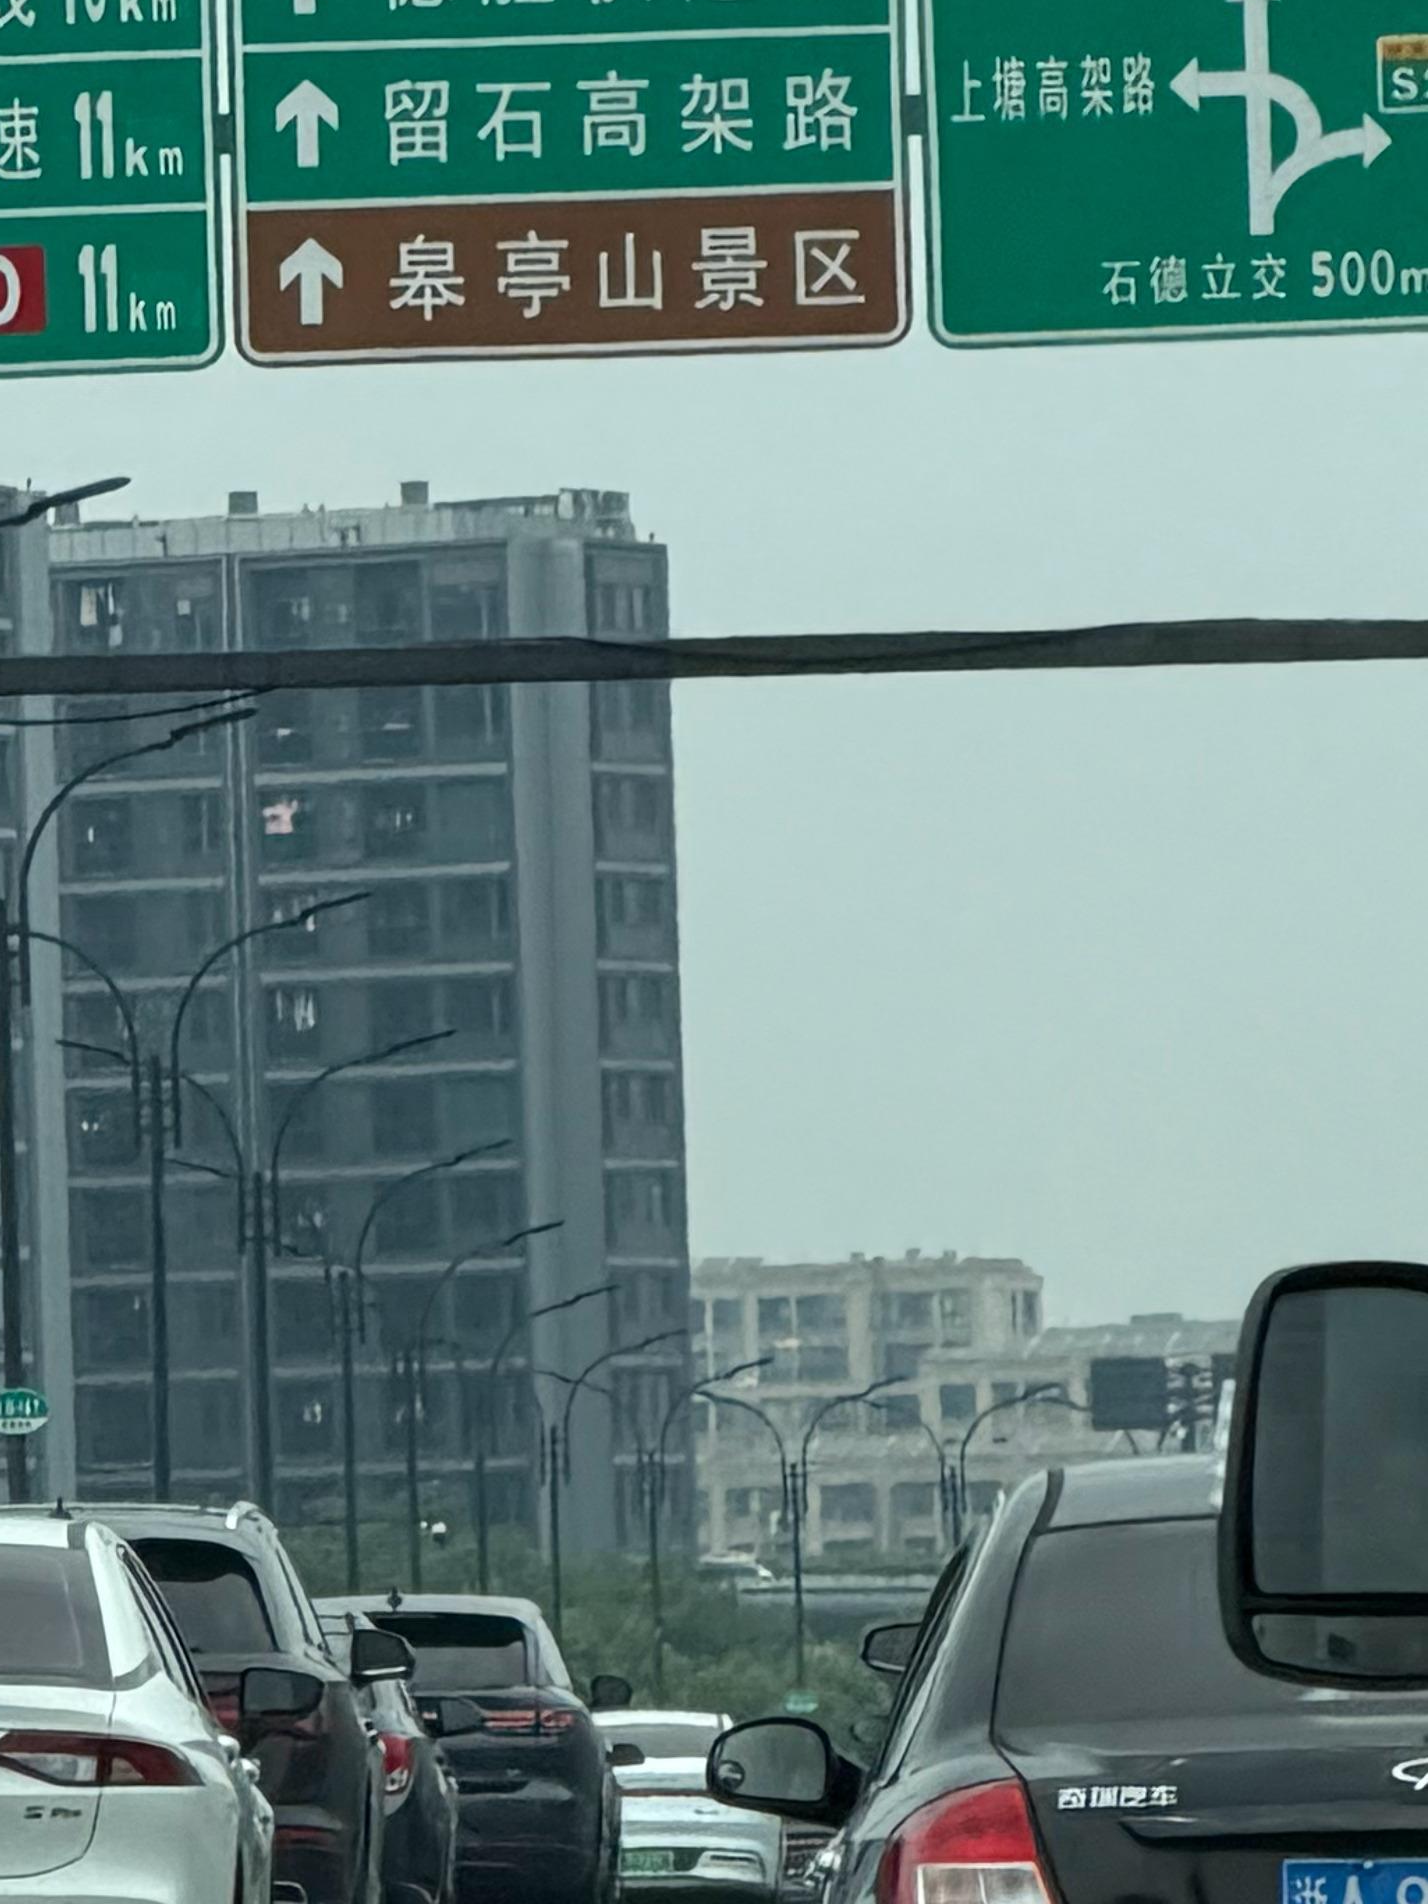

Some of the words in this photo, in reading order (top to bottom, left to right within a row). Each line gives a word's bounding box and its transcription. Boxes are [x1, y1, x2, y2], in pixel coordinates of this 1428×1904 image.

[384, 68, 858, 167] 留石高架路
[951, 52, 1155, 123] 上塘高架路
[73, 91, 183, 179] 11km
[78, 244, 175, 332] 11km
[389, 226, 864, 321] 皋亭山景区
[1101, 253, 1287, 305] 石德立交
